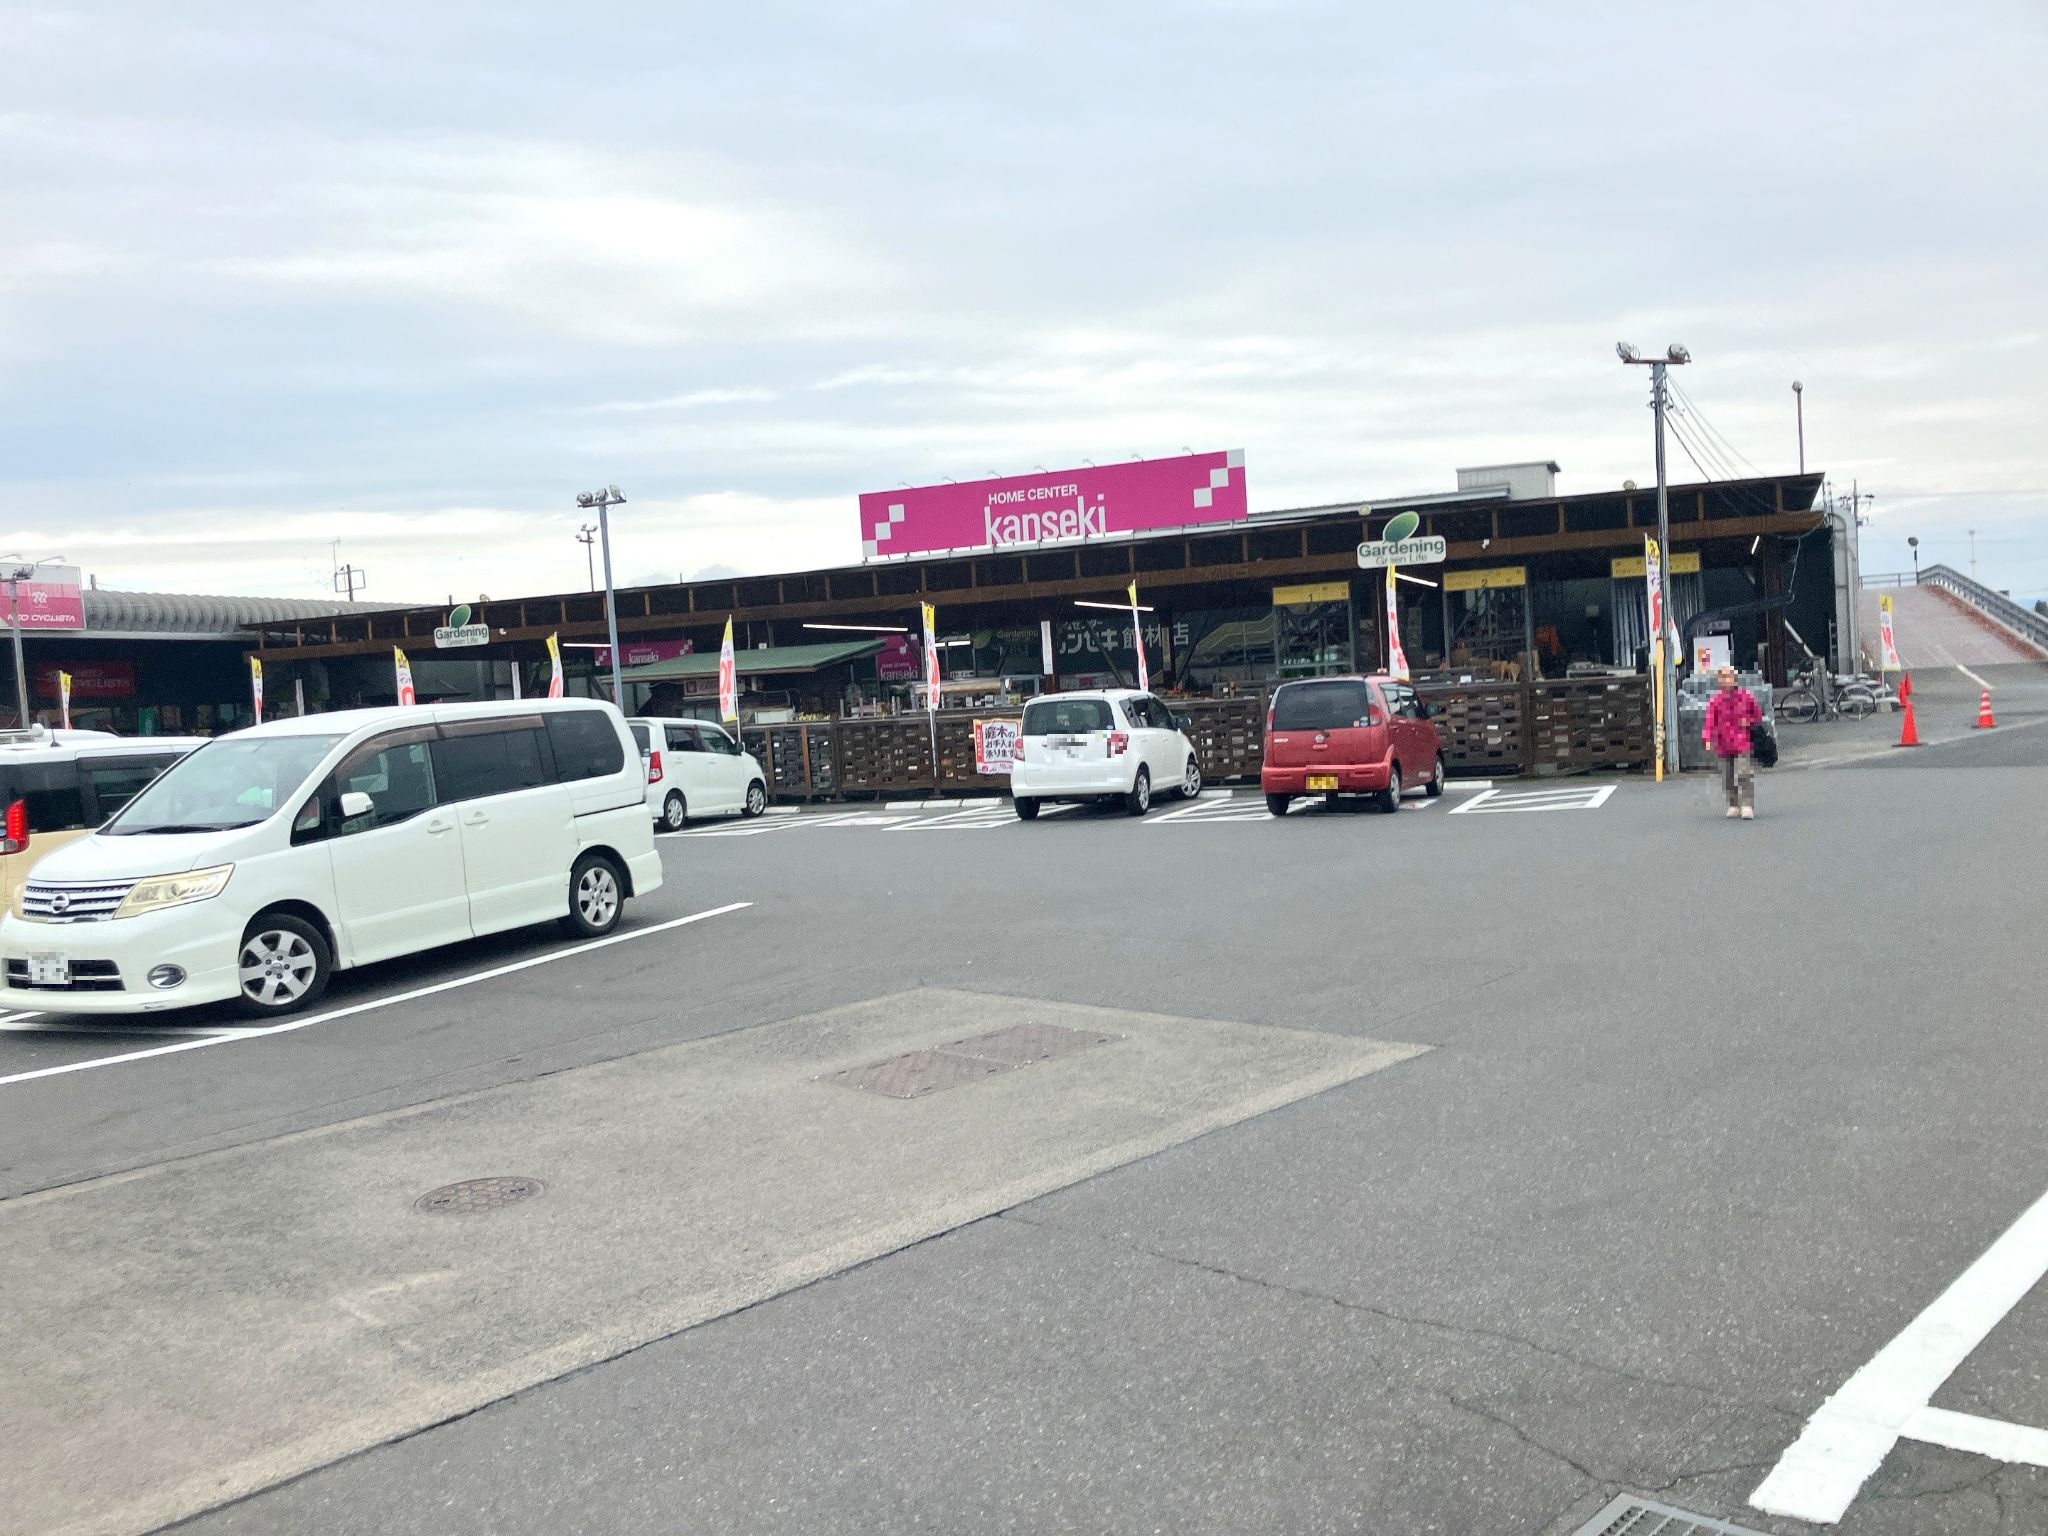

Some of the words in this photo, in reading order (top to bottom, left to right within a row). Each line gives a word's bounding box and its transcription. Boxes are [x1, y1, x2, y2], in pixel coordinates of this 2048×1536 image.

[988, 490, 1025, 505] HOME
[1027, 484, 1078, 501] CENTER
[984, 493, 1106, 546] kanseki
[1359, 540, 1444, 557] Gardening
[1409, 554, 1428, 562] Life
[31, 614, 76, 622] CYCLISTA
[435, 627, 488, 640] Gardening
[880, 665, 918, 681] kanseki
